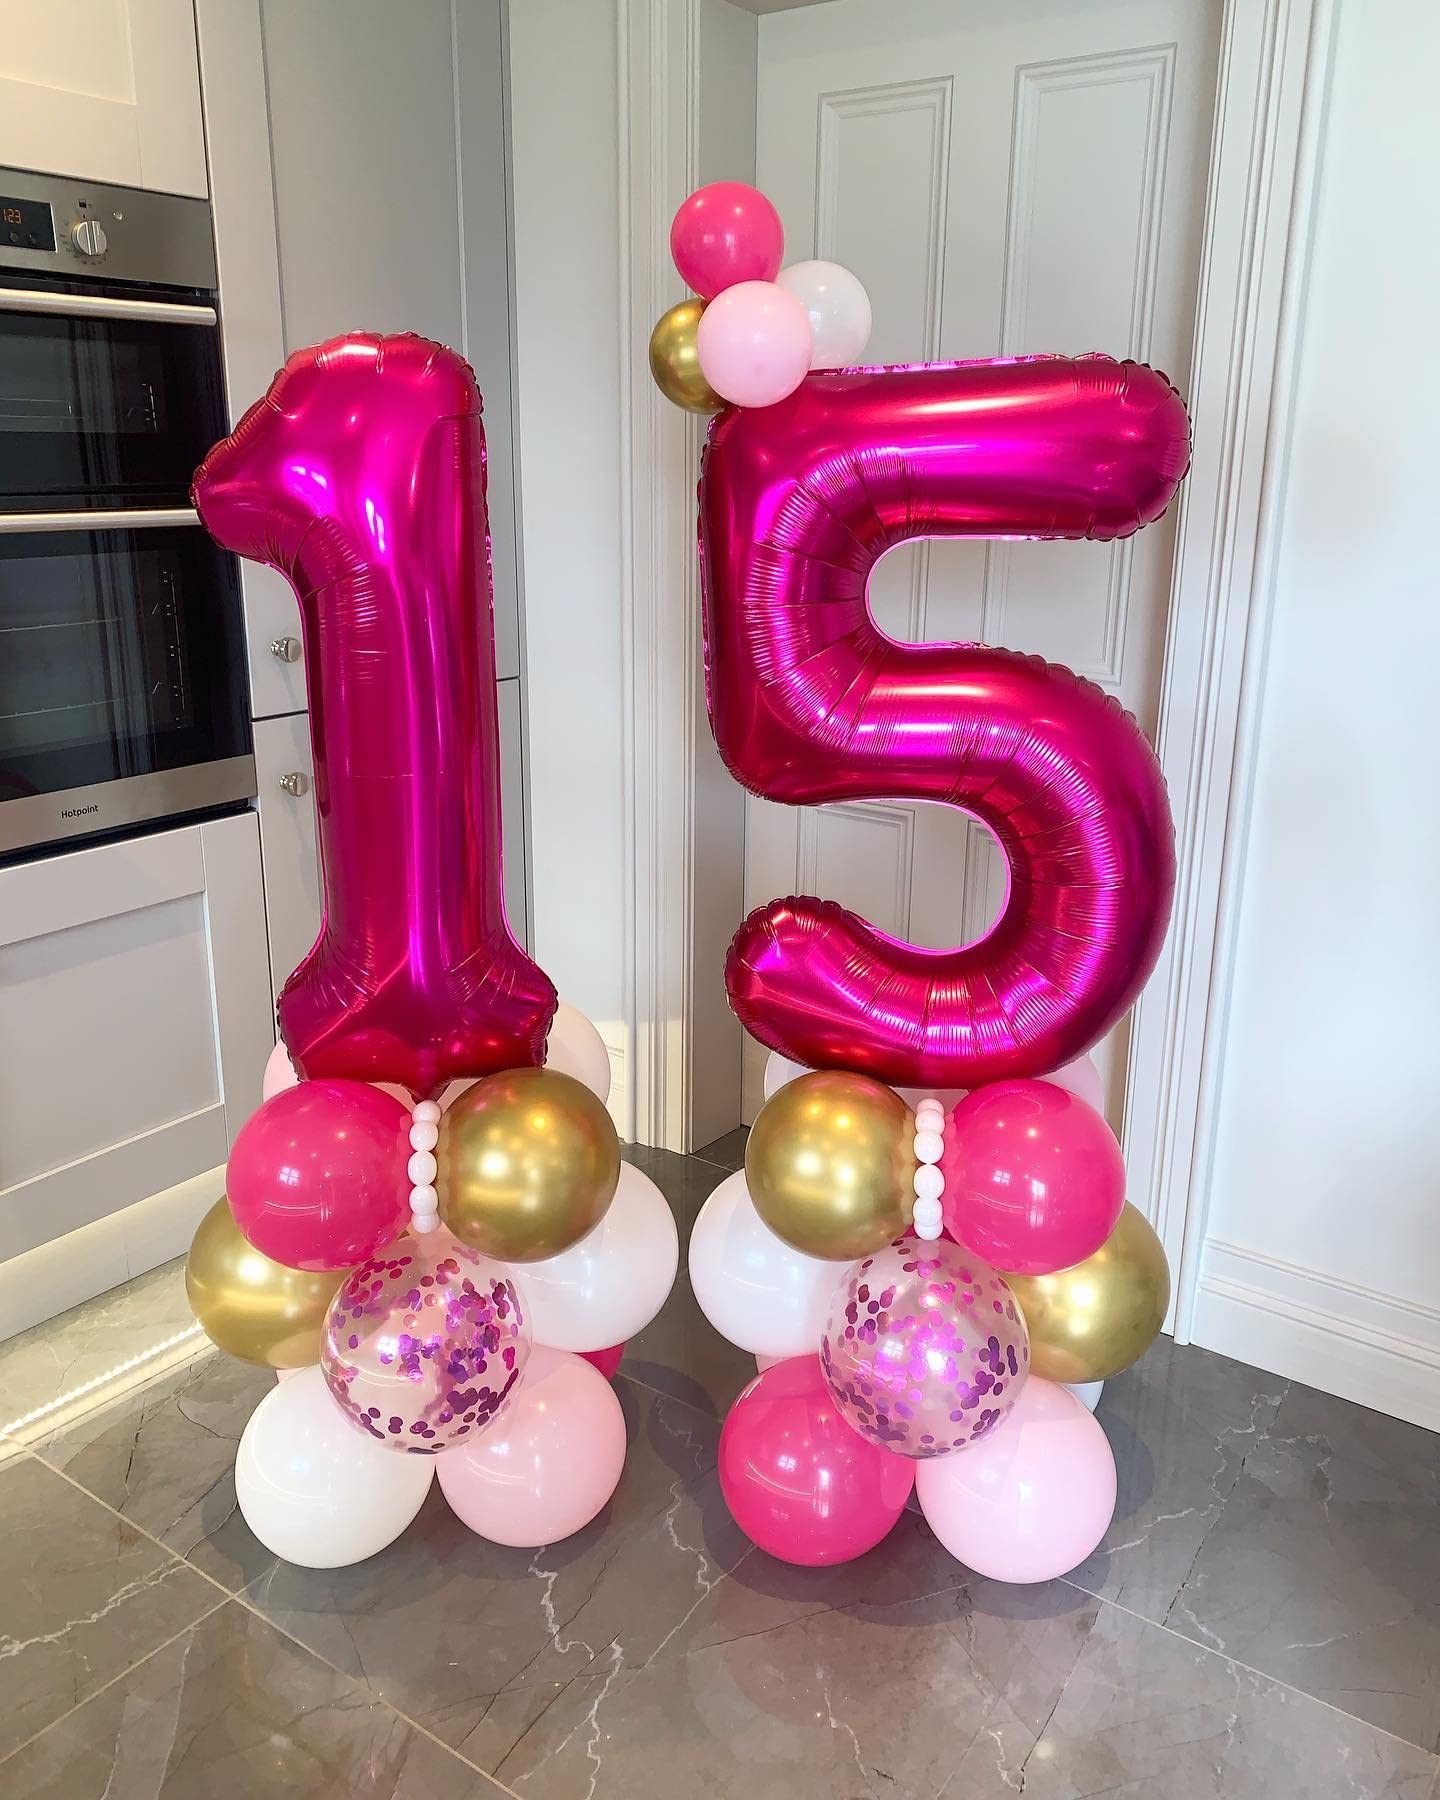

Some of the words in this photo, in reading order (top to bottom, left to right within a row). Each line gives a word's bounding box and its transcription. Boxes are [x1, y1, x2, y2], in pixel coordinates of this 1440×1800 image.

[61, 804, 99, 819] Hotpoint
[191, 331, 558, 1094] 1
[698, 352, 1192, 1088] 5
